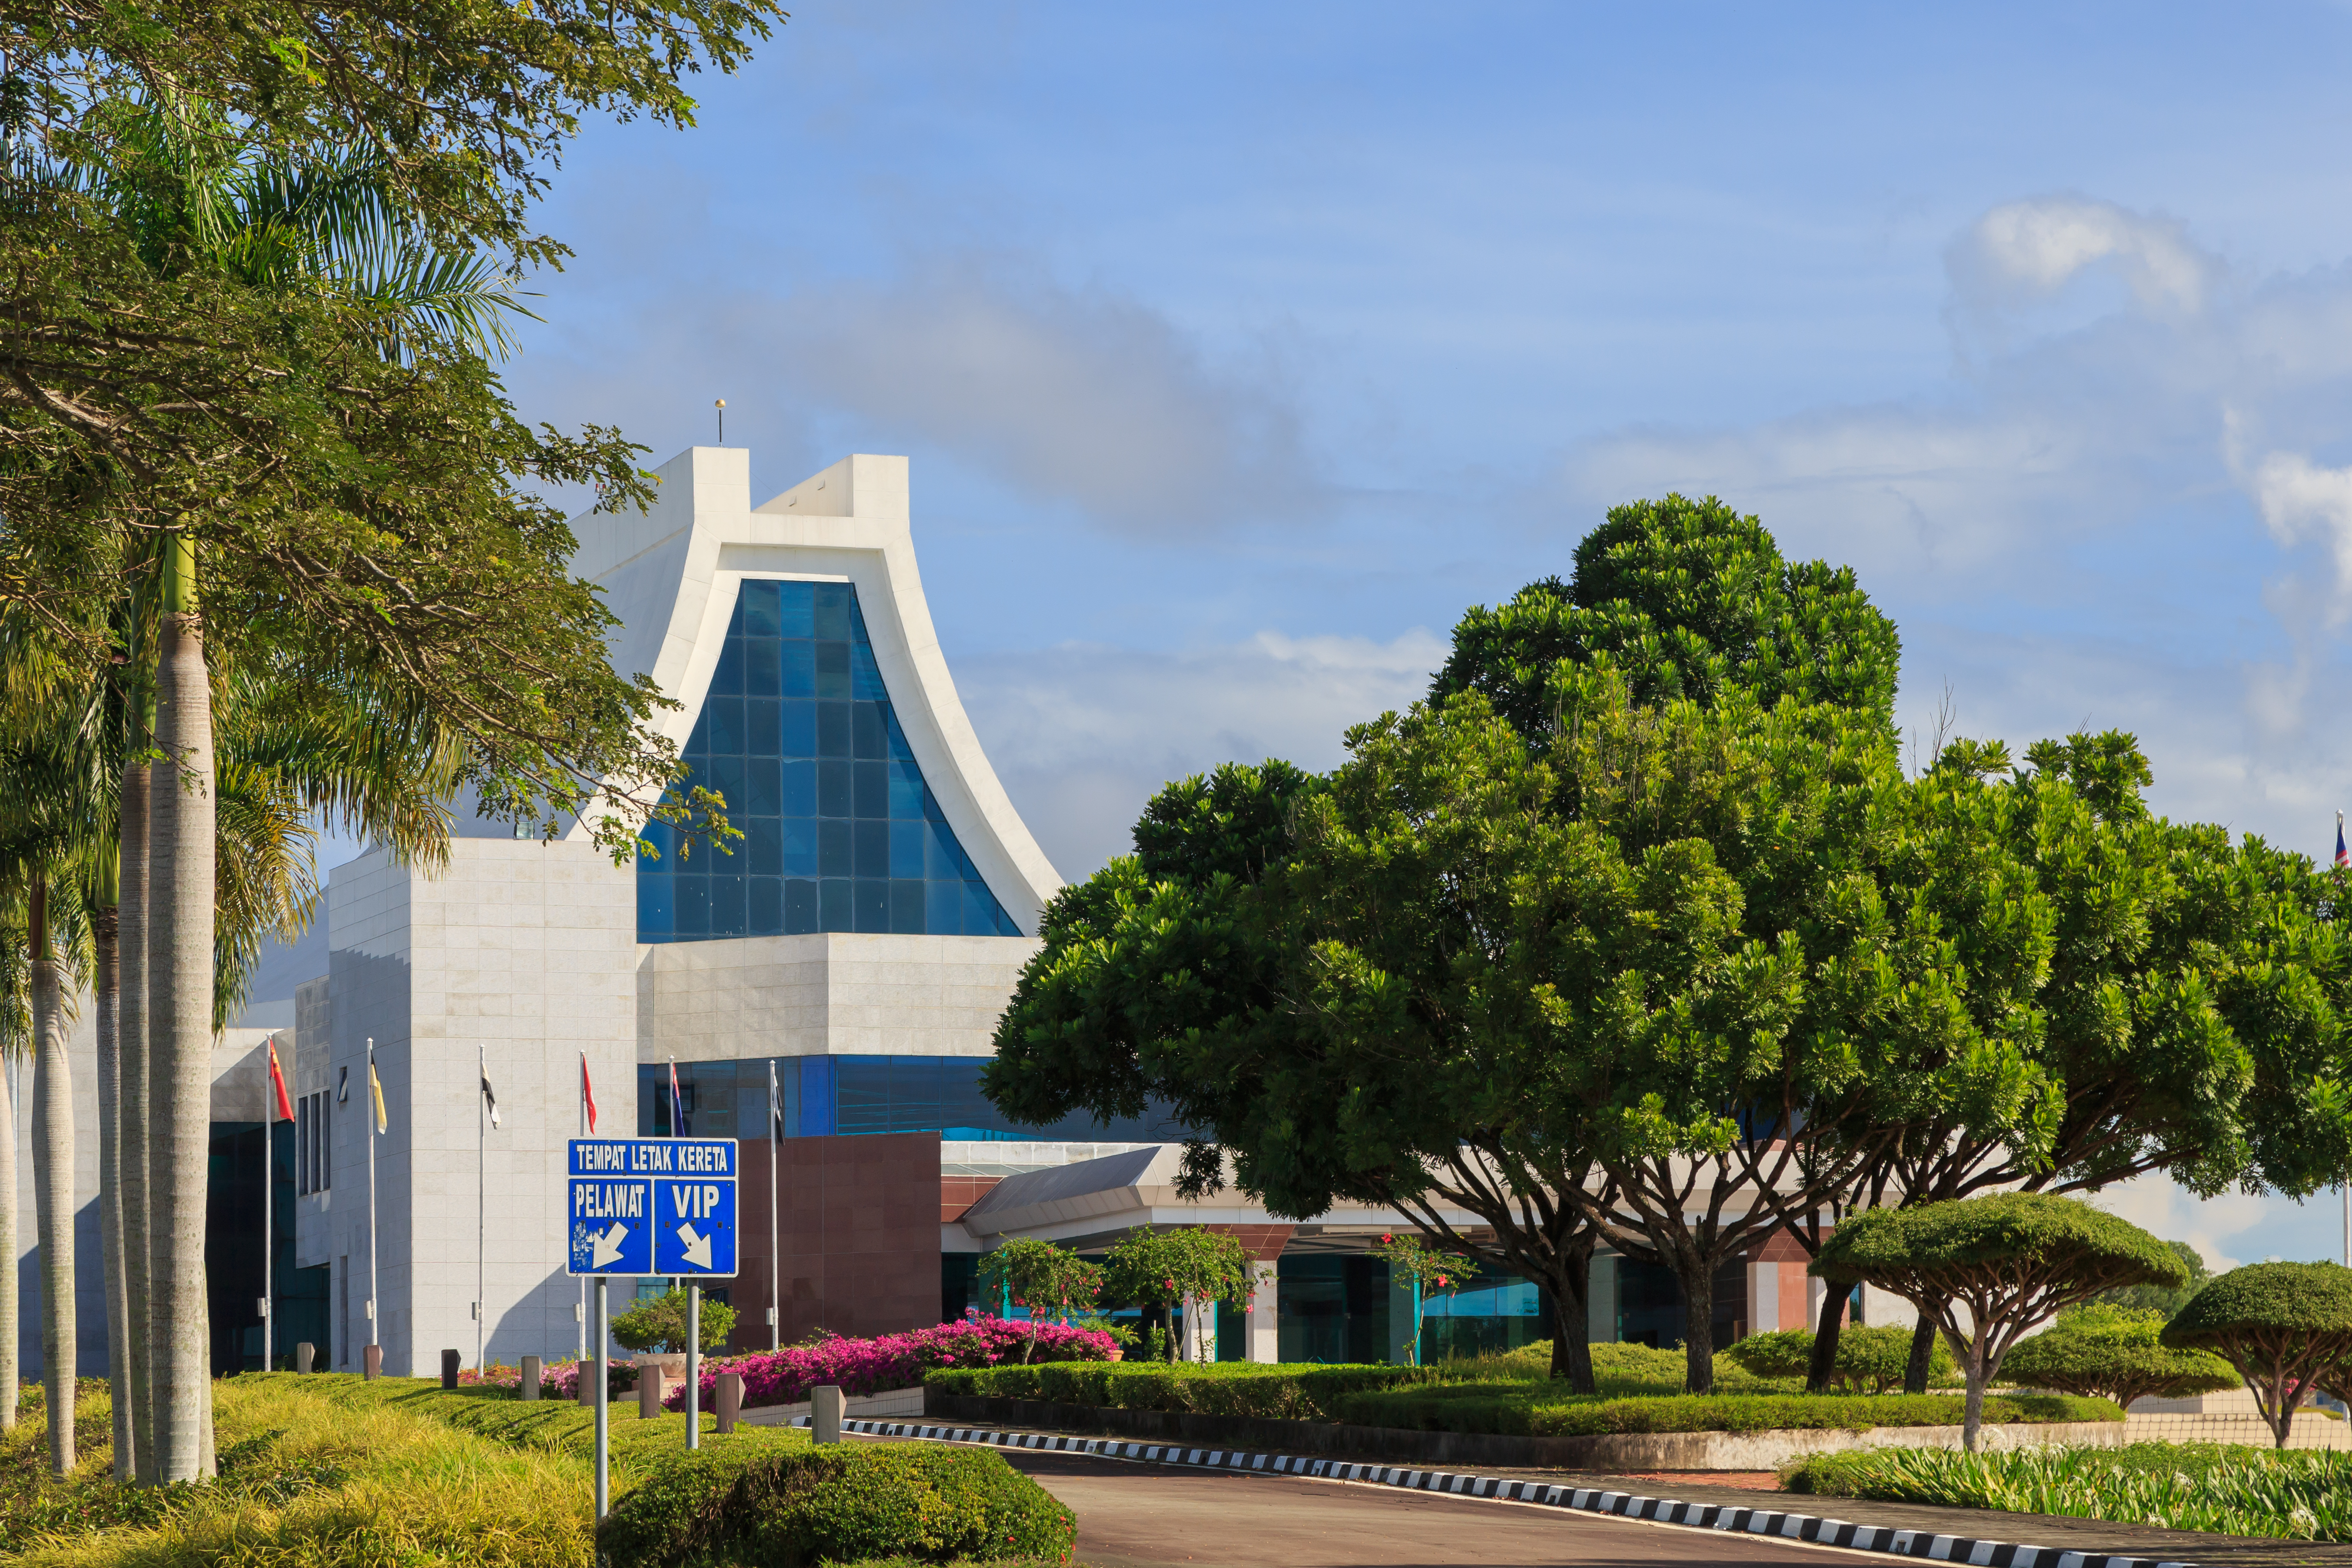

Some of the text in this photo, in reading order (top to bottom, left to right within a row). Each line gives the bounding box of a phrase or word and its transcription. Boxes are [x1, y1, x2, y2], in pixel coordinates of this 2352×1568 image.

[576, 1145, 728, 1171] TEMPAT LETAK KERETA
[576, 1184, 645, 1218] PELAWAT
[672, 1185, 719, 1218] VIP
